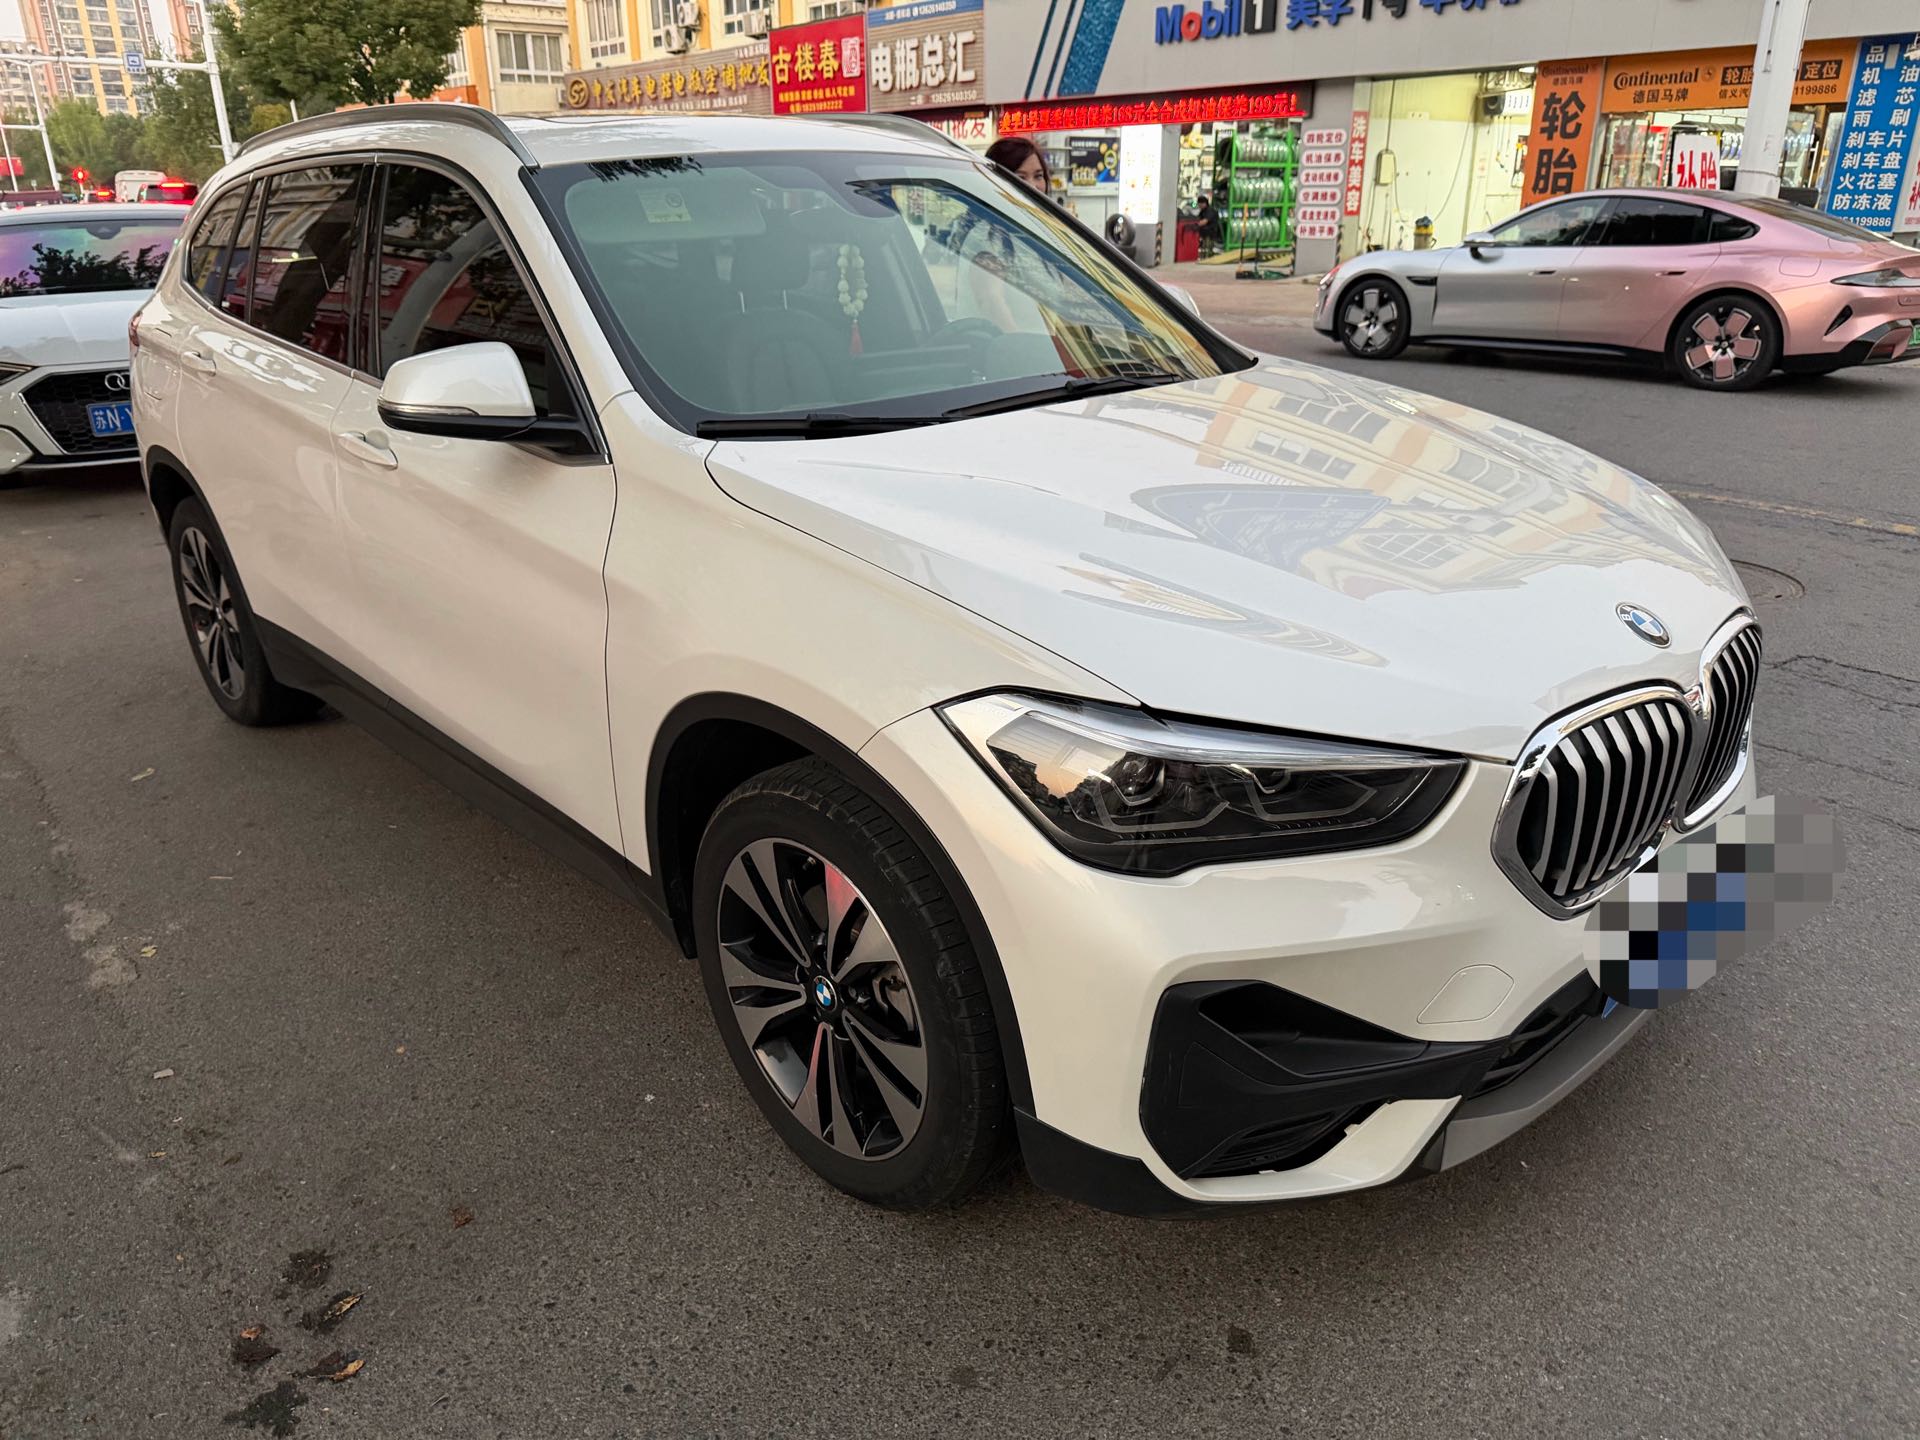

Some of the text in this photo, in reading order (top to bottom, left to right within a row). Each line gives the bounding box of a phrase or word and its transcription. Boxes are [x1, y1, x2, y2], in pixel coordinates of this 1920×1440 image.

[1155, 1, 1241, 44] Mobil
[772, 39, 839, 84] 古楼春
[871, 30, 976, 92] 电瓶总汇
[1804, 62, 1838, 79] 定位
[1614, 68, 1699, 90] Continental
[1632, 88, 1689, 104] 德国马牌
[1856, 88, 1915, 106] 滤芯
[1852, 108, 1911, 127] 雨刷
[1532, 91, 1586, 195] 轮胎
[1845, 130, 1907, 149] 刹车片
[1346, 115, 1367, 212] 洗车美容
[1841, 152, 1903, 170] 刹车盘
[1837, 172, 1899, 191] 火花塞
[1832, 193, 1894, 211] 防冻液
